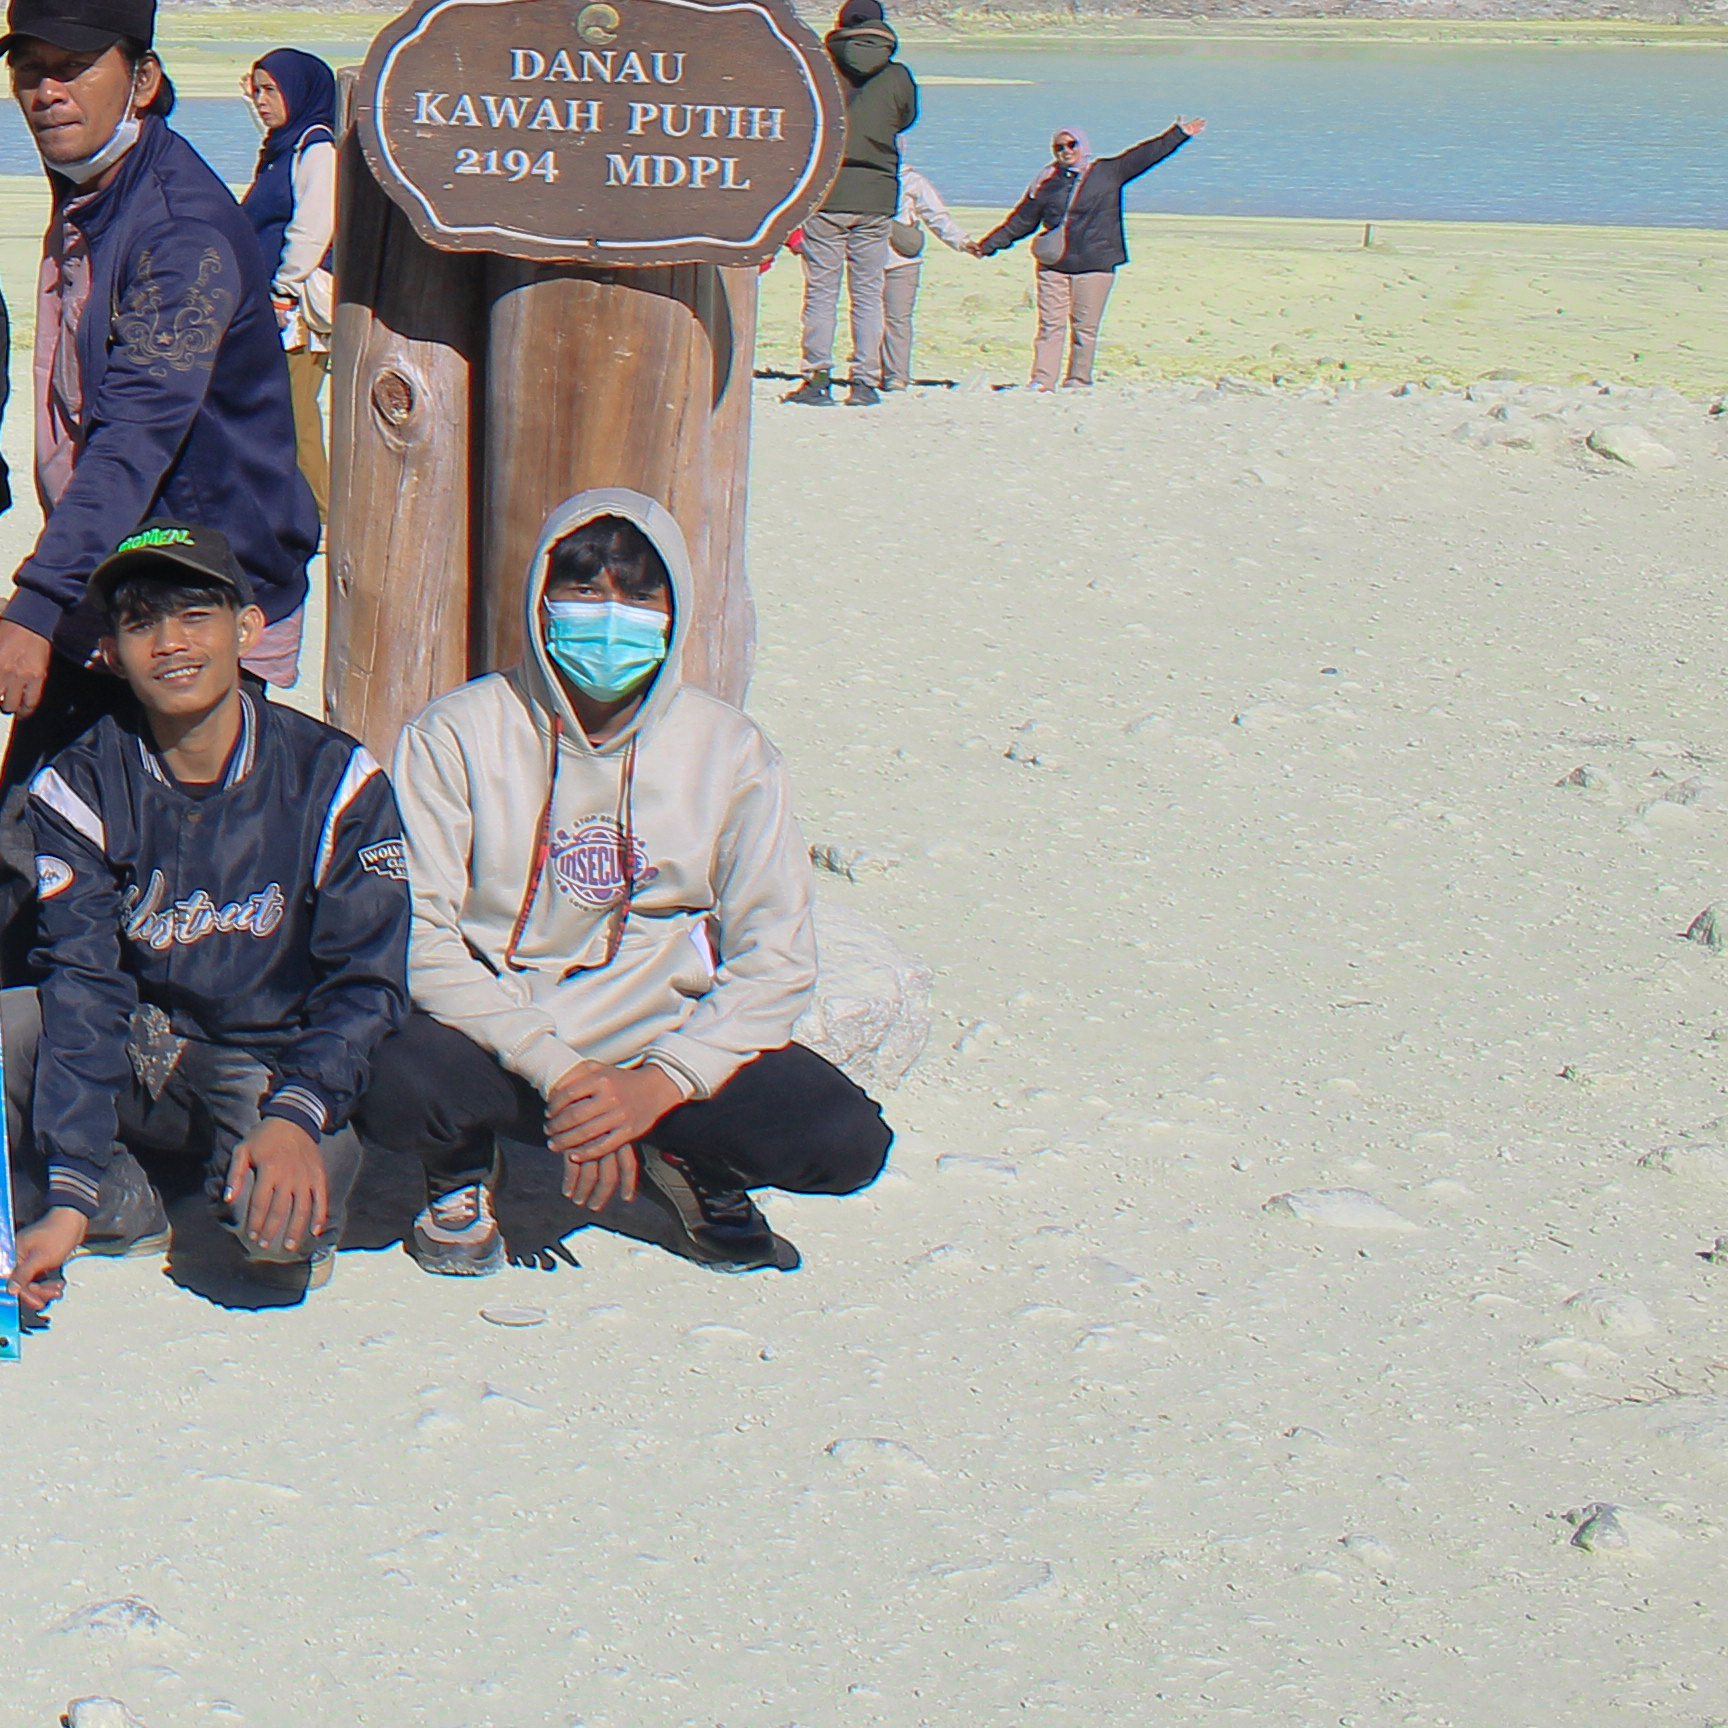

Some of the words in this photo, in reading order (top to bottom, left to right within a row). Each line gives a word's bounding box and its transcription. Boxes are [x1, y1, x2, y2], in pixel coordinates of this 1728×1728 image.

[511, 49, 686, 84] DANAU
[413, 92, 603, 133] KAWAH
[628, 102, 785, 141] PUTIH
[454, 148, 559, 183] 2194
[605, 154, 750, 190] MDPL
